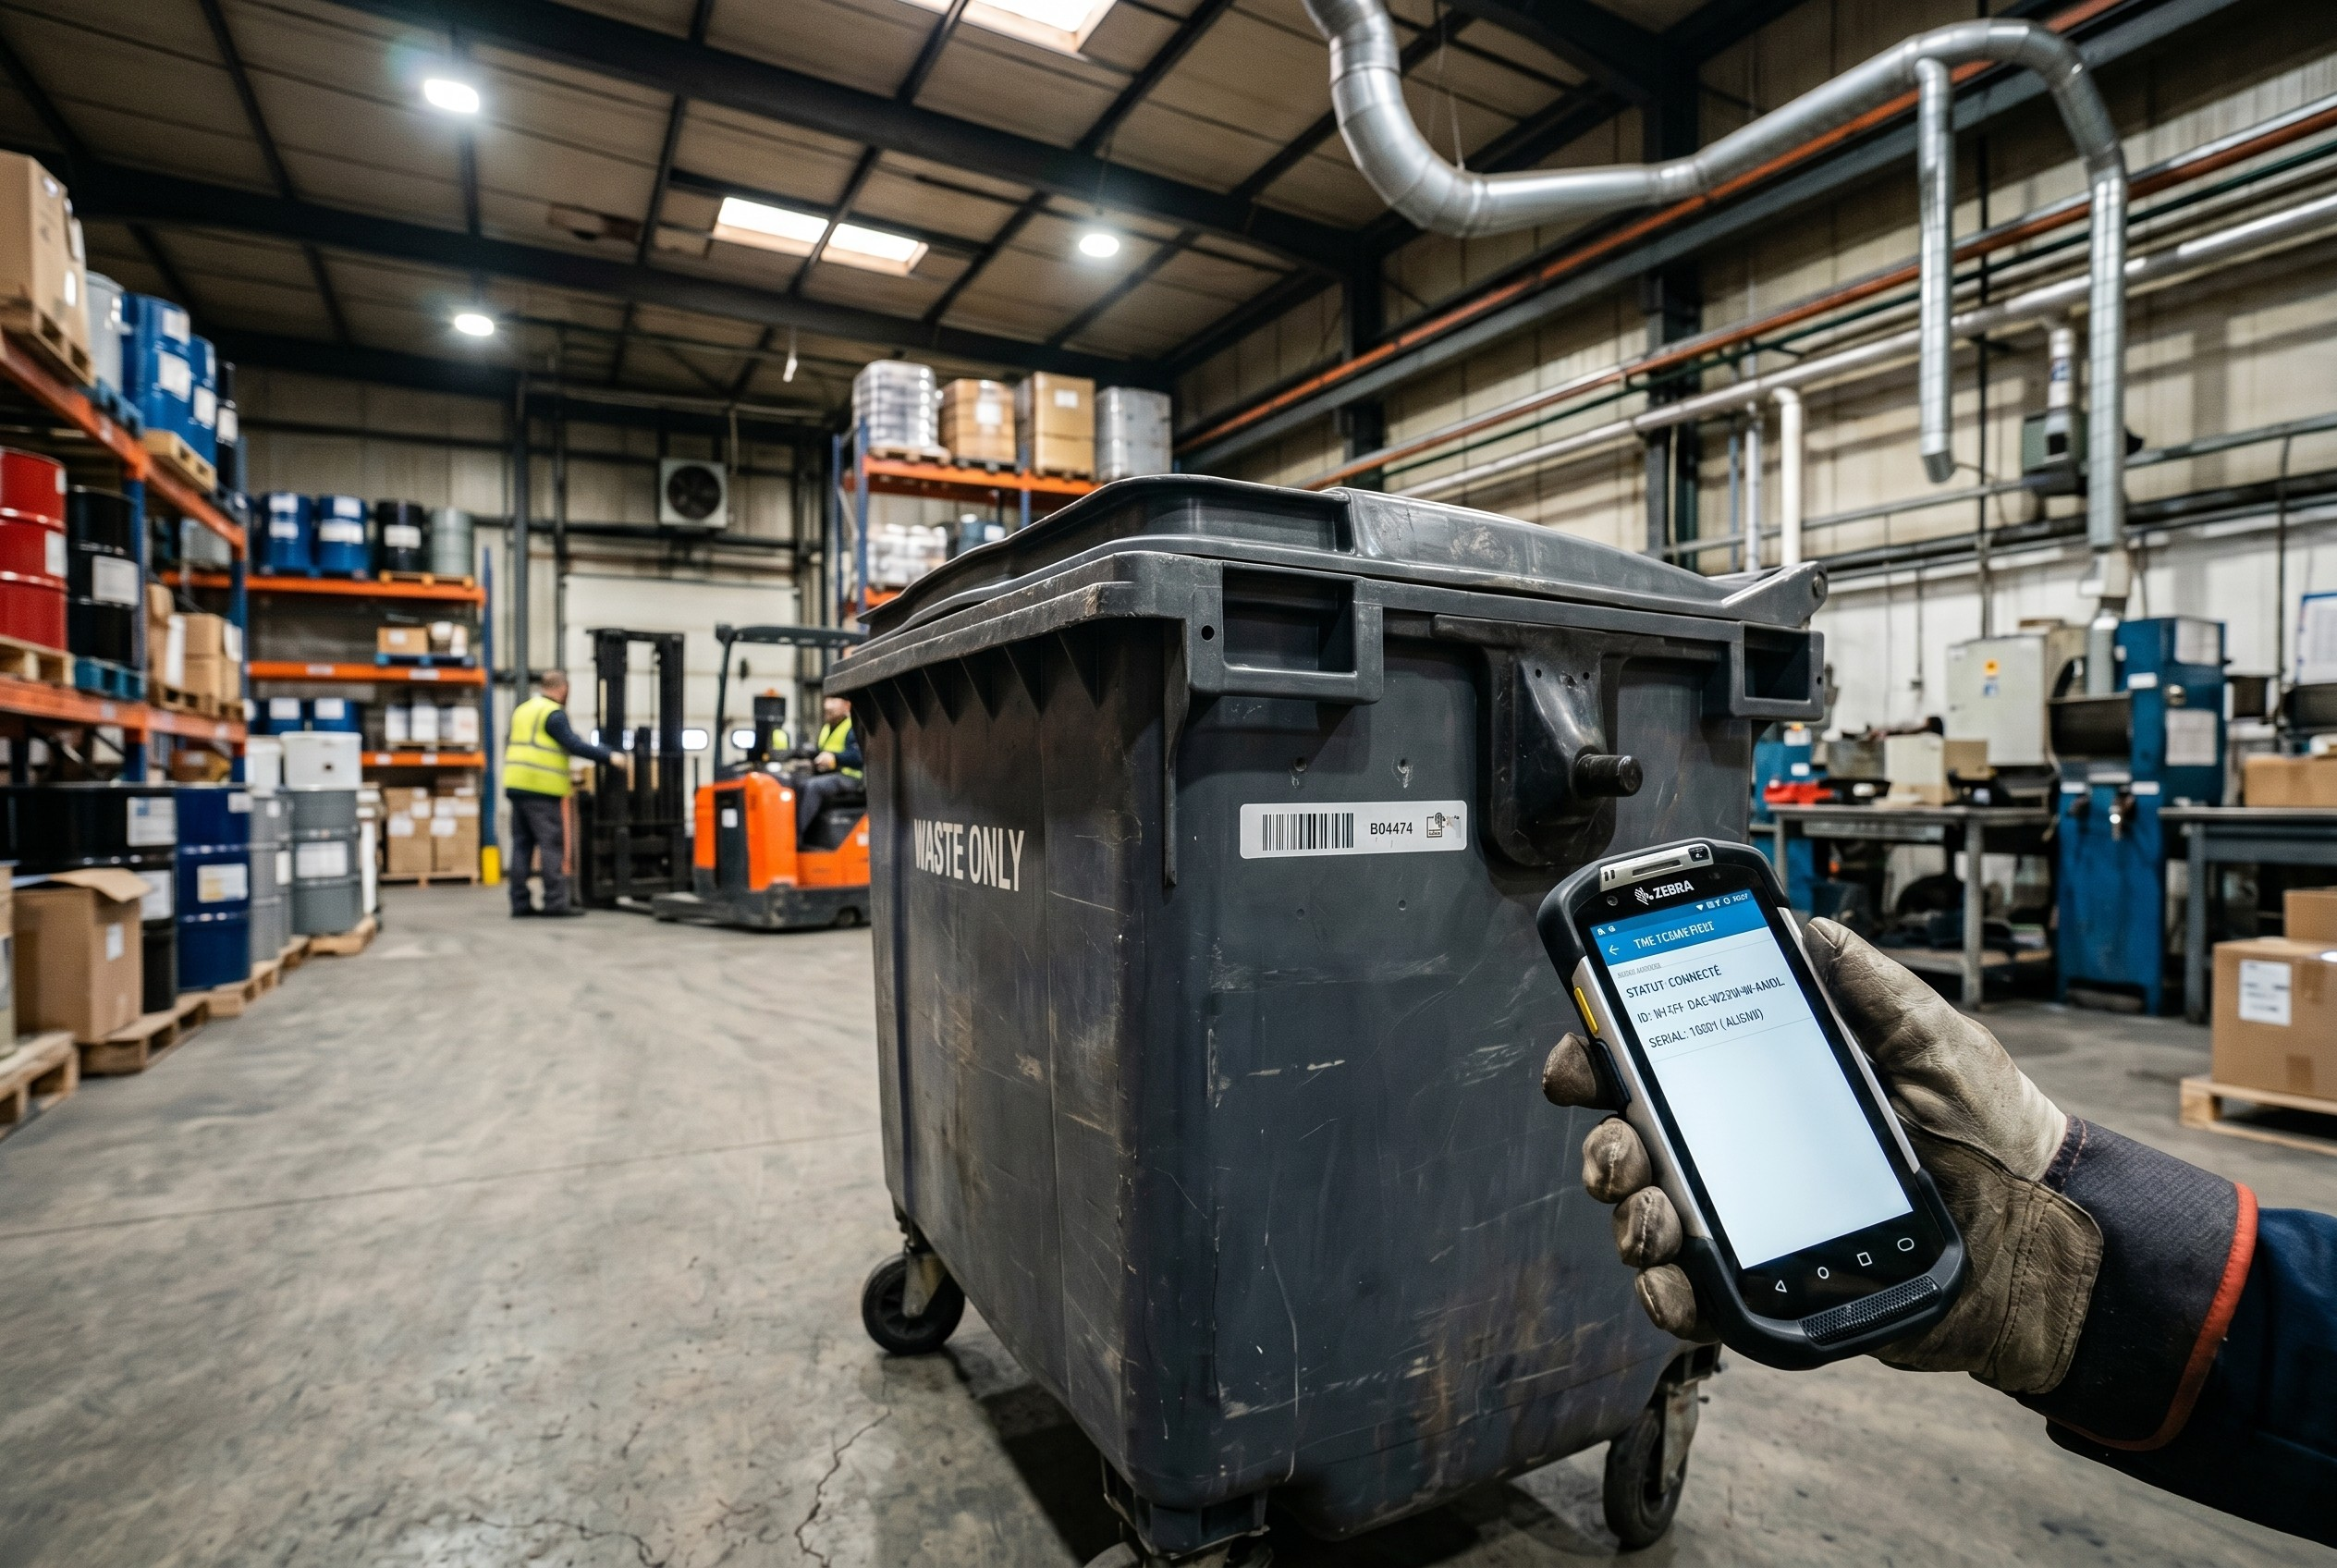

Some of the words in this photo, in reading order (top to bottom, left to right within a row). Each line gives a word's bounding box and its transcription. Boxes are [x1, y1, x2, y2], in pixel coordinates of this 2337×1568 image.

[1370, 822, 1413, 835] B04474
[913, 818, 964, 880] WASTE
[968, 825, 1025, 892] ONLY
[1653, 880, 1695, 899] ZEBRA
[1668, 964, 1722, 988] CONNECTÉ
[1637, 1012, 1653, 1023] ID:
[1648, 1030, 1689, 1047] SERIAL:
